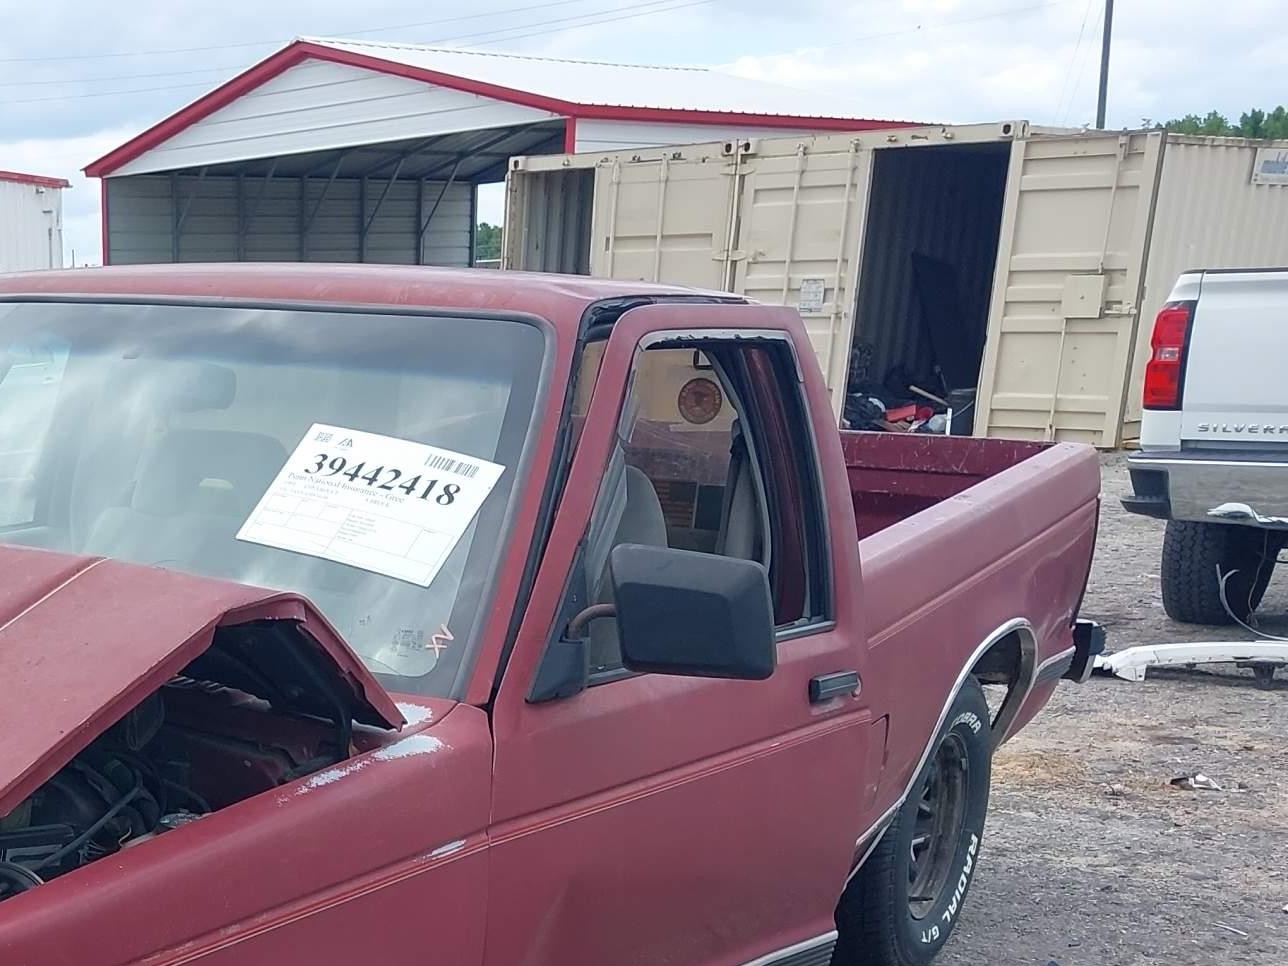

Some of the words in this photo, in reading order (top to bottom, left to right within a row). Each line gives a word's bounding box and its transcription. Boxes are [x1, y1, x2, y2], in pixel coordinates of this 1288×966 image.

[304, 453, 460, 506] 39442418
[942, 833, 979, 922] RADIAL
[921, 925, 940, 943] G/T
